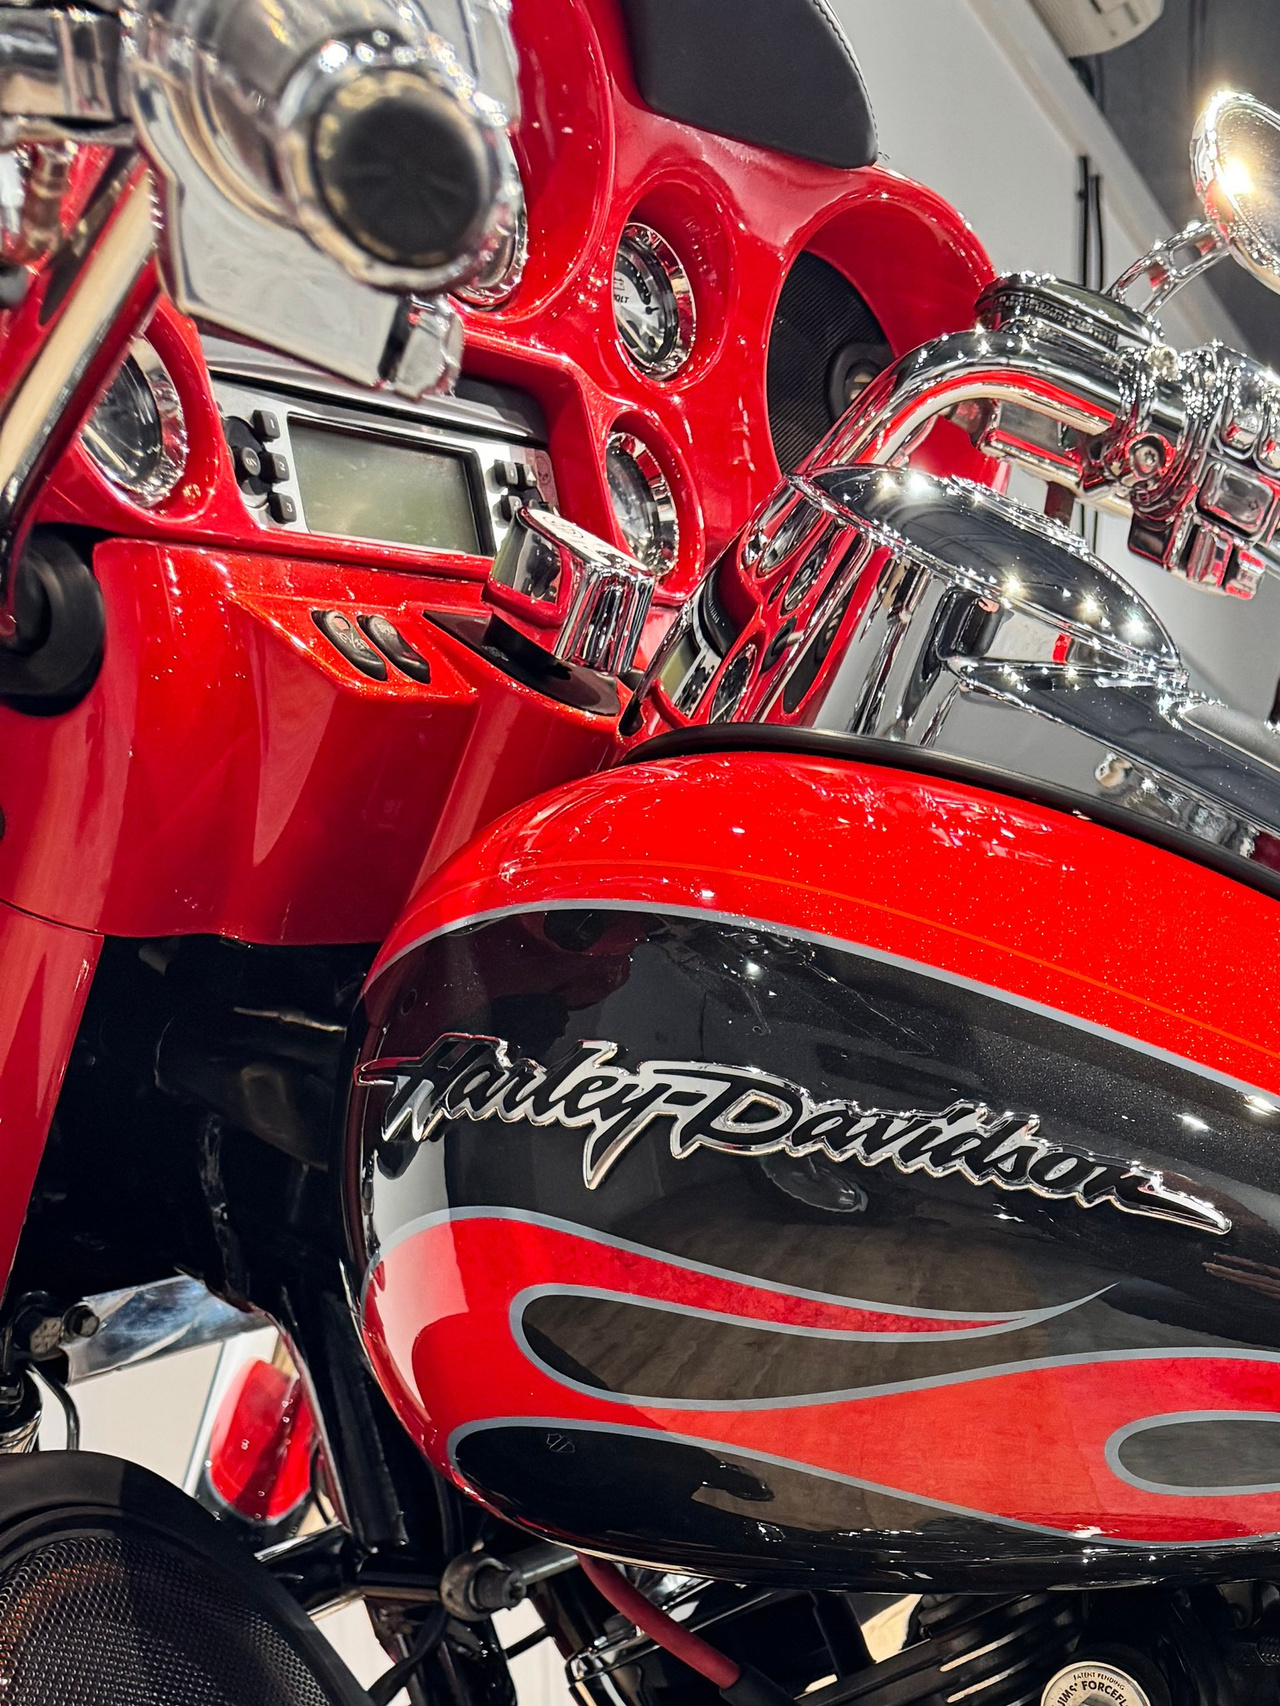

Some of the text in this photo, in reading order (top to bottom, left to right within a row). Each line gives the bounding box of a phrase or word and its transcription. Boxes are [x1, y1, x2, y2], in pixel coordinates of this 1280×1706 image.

[279, 461, 286, 472] 2
[285, 502, 293, 513] 3
[354, 1033, 1233, 1236] Harley-Davidson
[1072, 1672, 1125, 1690] PATENT PENDING
